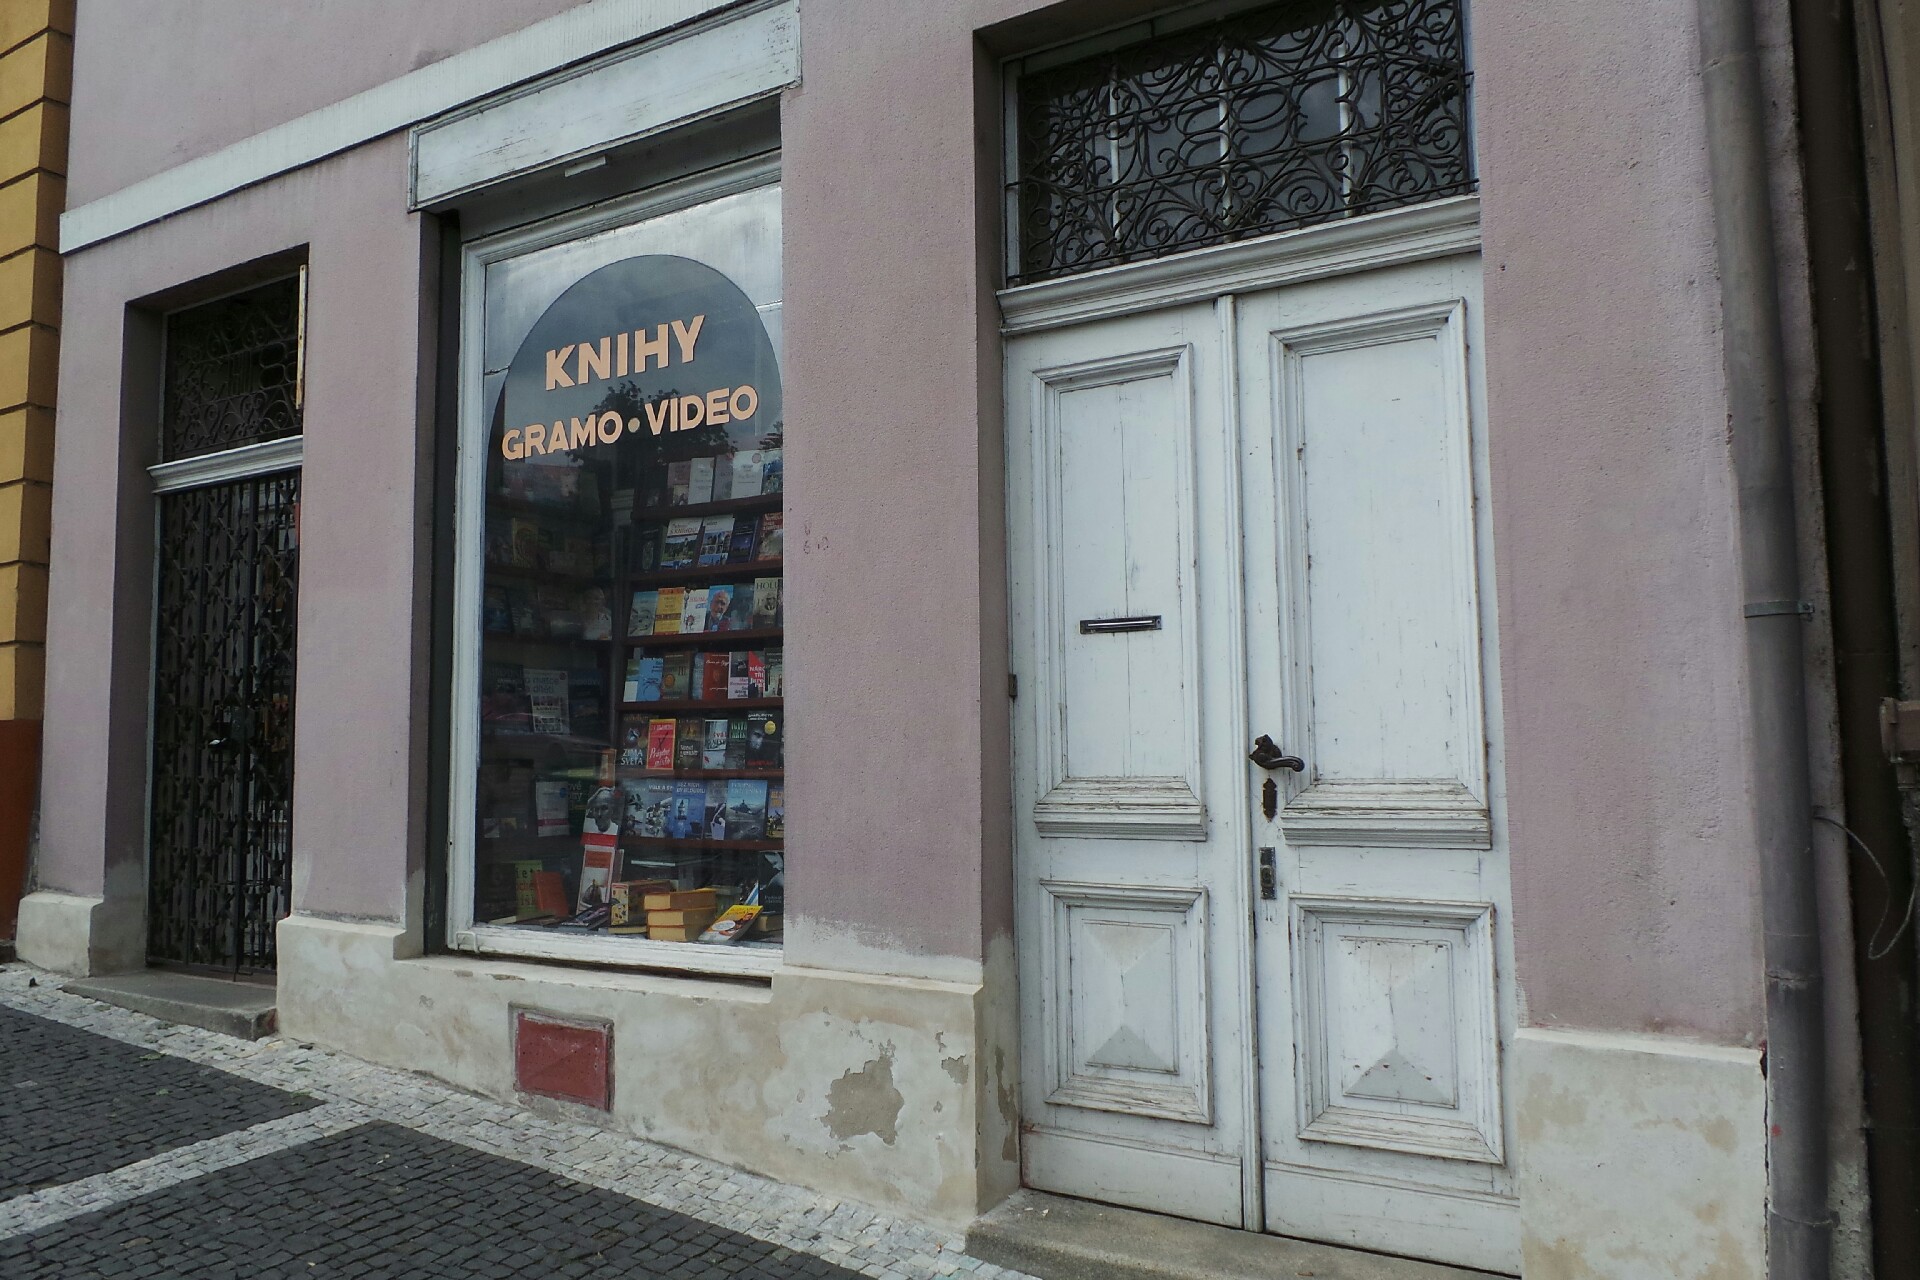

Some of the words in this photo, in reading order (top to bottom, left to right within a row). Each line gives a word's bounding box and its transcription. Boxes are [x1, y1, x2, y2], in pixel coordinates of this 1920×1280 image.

[545, 314, 706, 391] KNIHY
[501, 411, 623, 461] GRAMO
[644, 385, 759, 436] VIDEO
